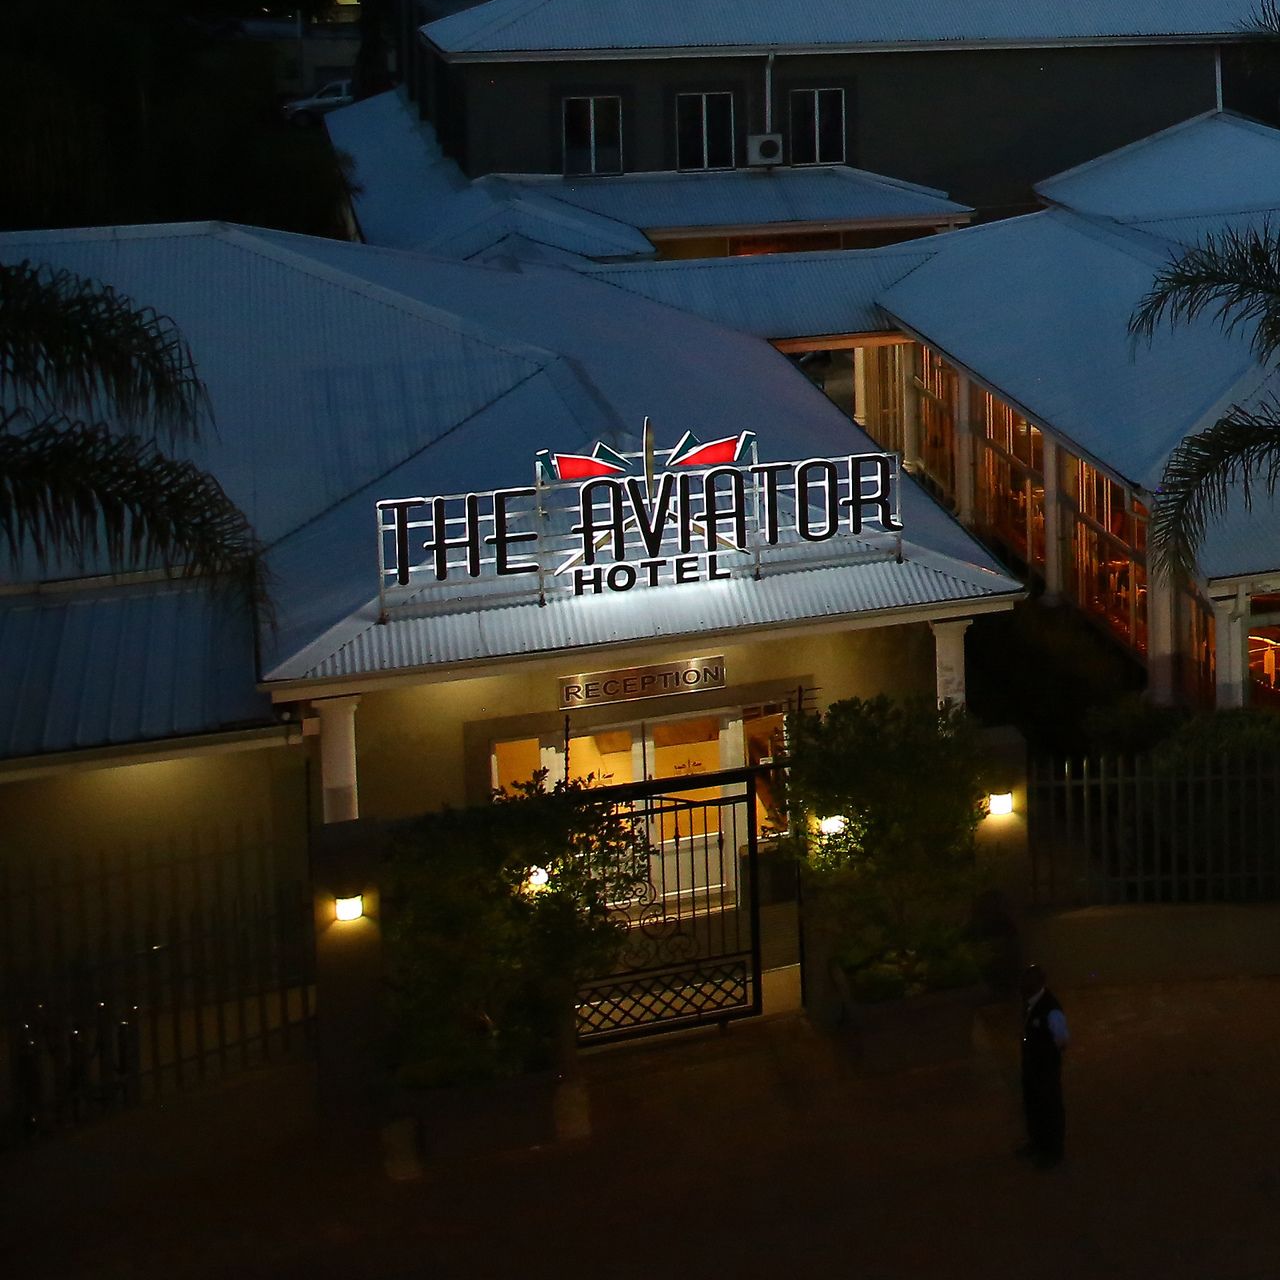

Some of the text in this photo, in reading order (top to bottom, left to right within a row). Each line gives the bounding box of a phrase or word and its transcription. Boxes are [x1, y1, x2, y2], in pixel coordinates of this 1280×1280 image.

[375, 452, 904, 587] THE AVIATOR
[572, 551, 732, 596] HOTEL
[564, 665, 720, 702] RECEPTION
